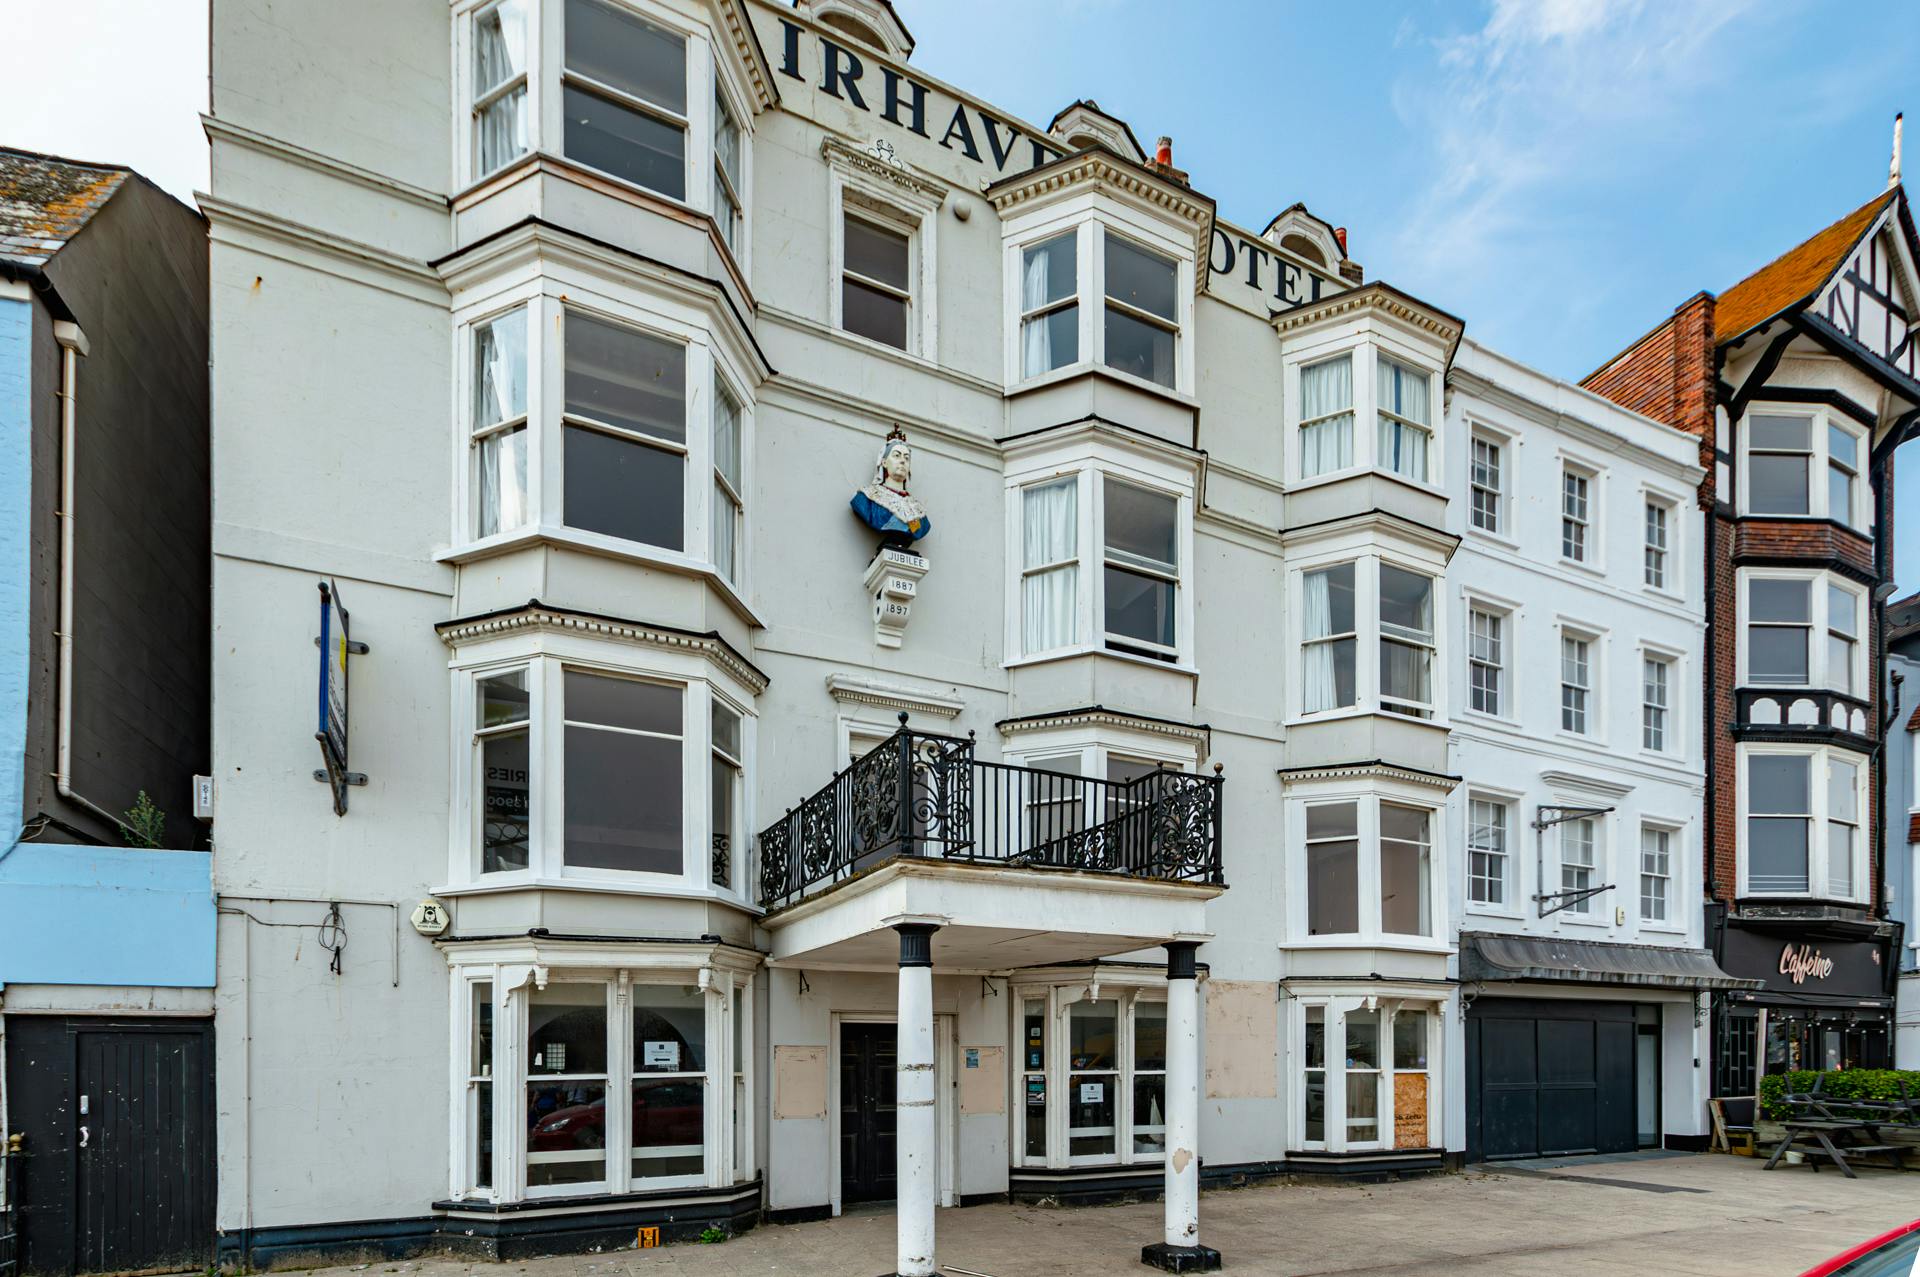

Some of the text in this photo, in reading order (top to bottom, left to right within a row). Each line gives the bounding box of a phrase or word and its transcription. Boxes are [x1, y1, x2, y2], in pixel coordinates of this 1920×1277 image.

[888, 552, 925, 568] JUBILEE
[891, 579, 914, 592] 1887
[886, 603, 908, 616] 1897
[1779, 943, 1834, 984] Caffeine
